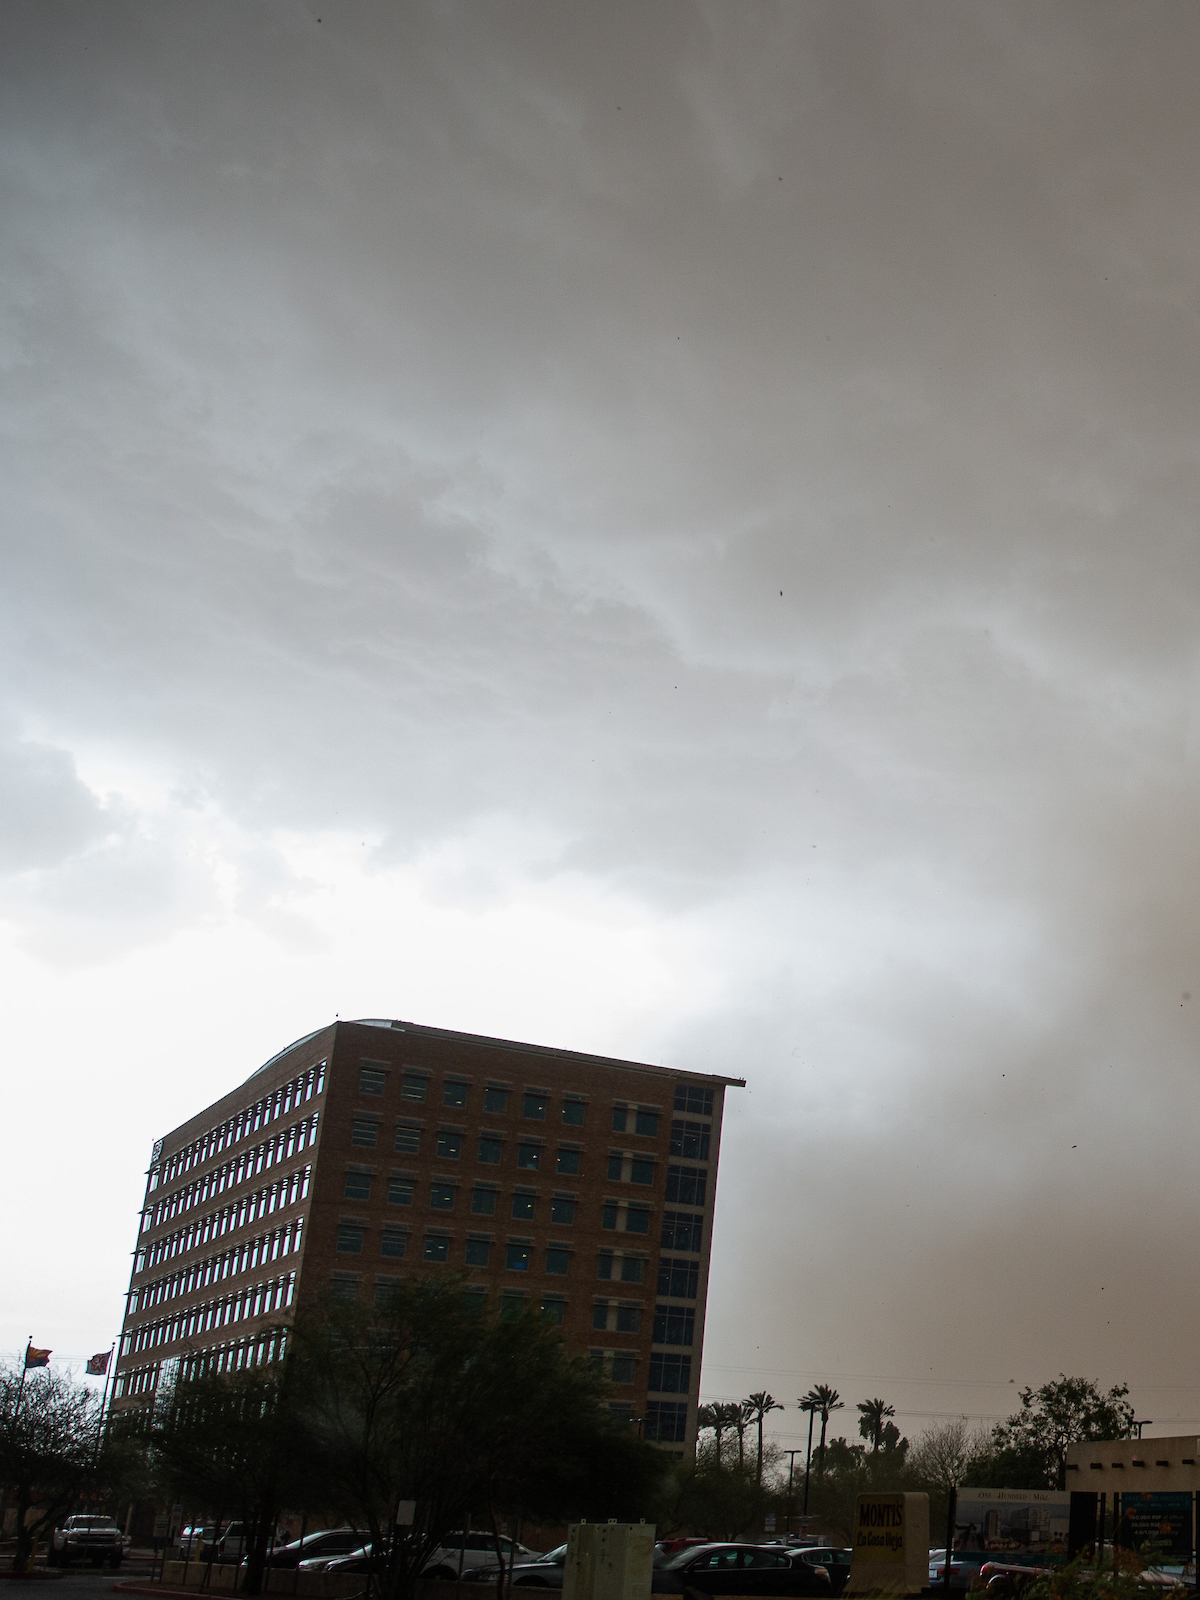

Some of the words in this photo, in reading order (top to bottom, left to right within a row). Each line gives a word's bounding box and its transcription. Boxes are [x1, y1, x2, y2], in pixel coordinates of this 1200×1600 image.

[859, 1499, 903, 1527] MONTI'S
[856, 1531, 867, 1547] La
[867, 1531, 885, 1546] Casa
[885, 1531, 903, 1552] Vieja
